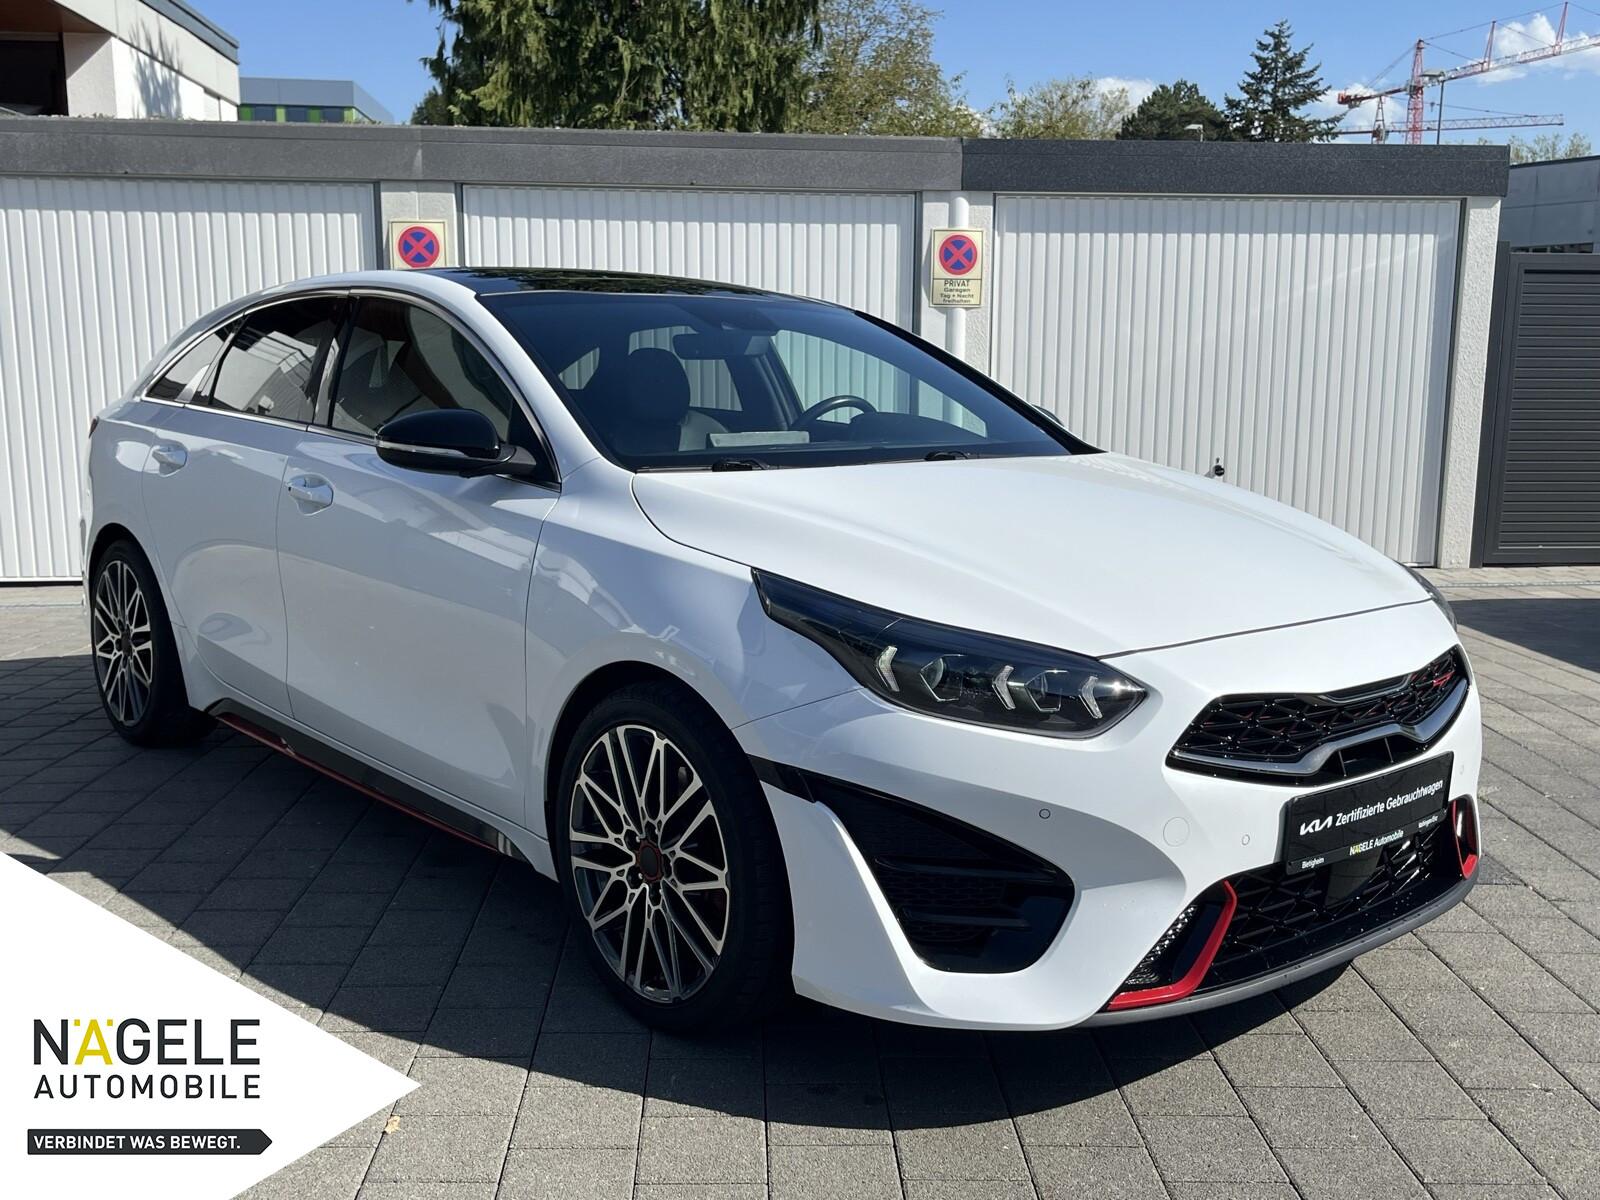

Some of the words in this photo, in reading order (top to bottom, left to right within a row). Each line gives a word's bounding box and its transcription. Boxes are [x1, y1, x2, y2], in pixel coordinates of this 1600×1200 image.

[1299, 816, 1332, 836] KIA
[1335, 801, 1385, 827] Zertifizierte
[1386, 780, 1444, 809] Gebrauchtwagen
[1374, 829, 1404, 848] Automobile
